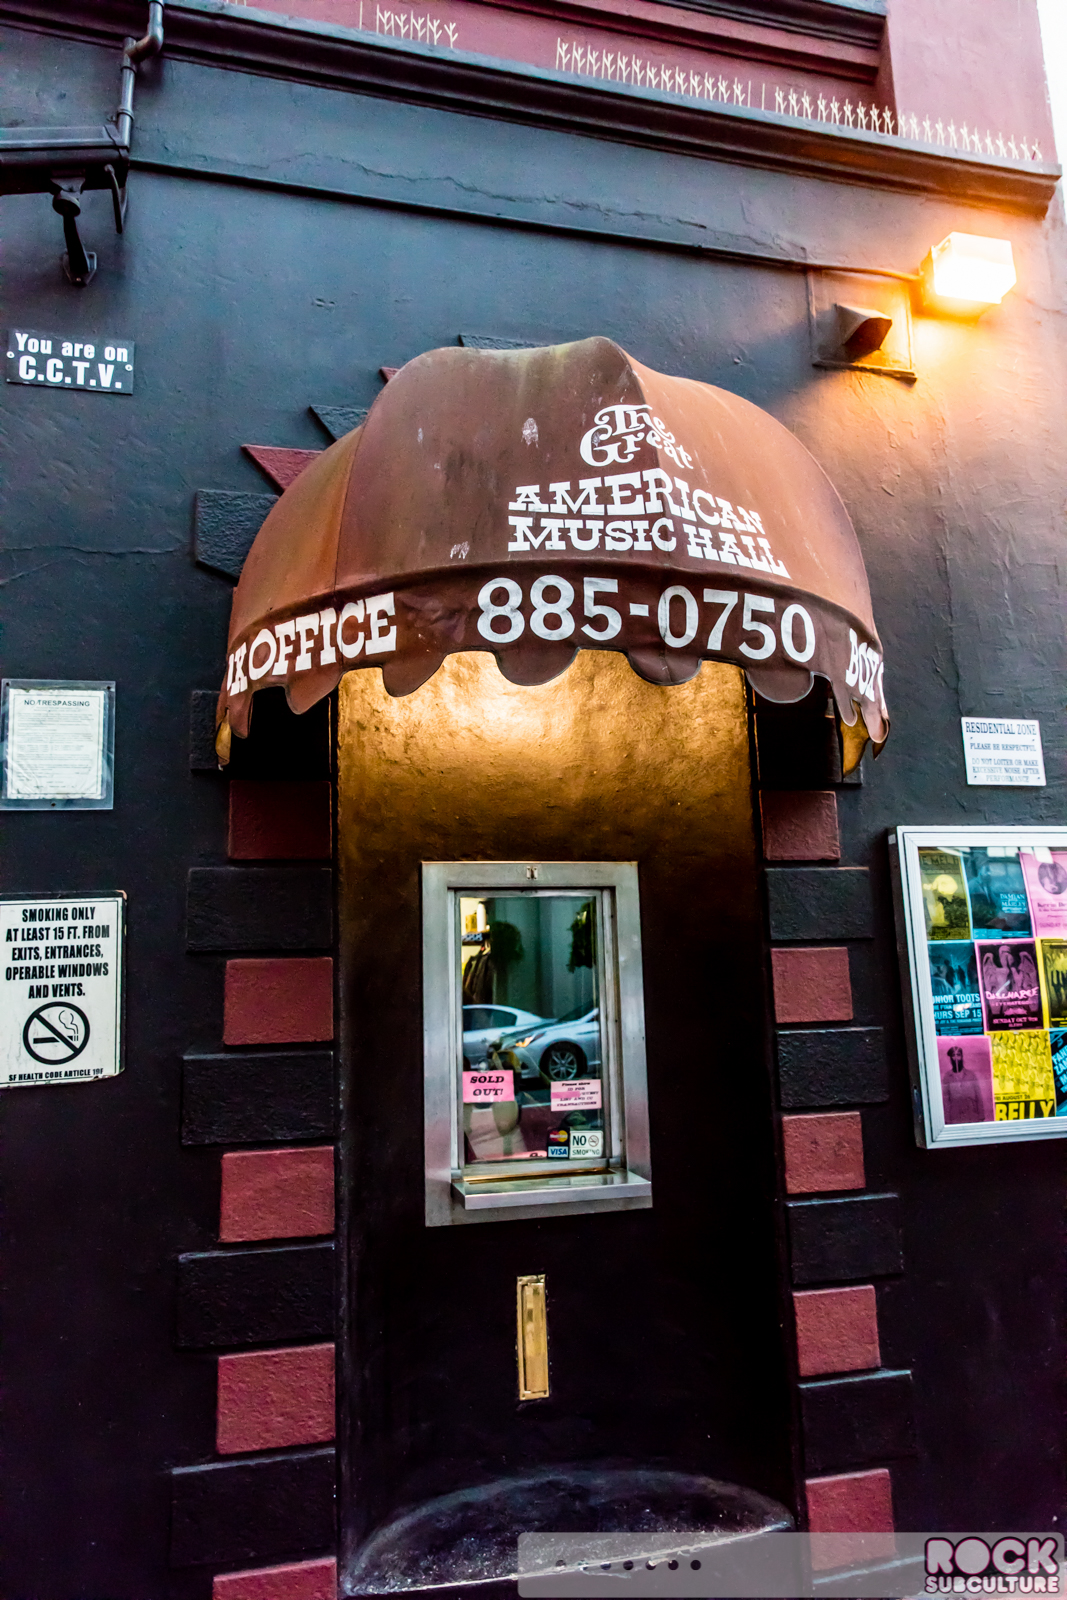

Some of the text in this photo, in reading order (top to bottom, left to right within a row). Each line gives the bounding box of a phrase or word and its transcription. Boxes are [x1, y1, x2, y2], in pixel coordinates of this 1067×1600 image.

[15, 332, 128, 362] You are on
[19, 355, 122, 388] C.C.T.V.
[594, 404, 676, 443] The
[579, 424, 694, 470] Great
[508, 467, 766, 535] AMERICAN
[508, 515, 792, 580] MUSIC HALL
[477, 574, 816, 664] 885-0750
[248, 592, 397, 681] OFFICE
[845, 628, 880, 702] BOX
[37, 699, 91, 707] TRESPASSING
[965, 721, 1037, 735] RESIDENTIAL ZONE
[970, 742, 992, 750] PLEASE
[993, 743, 1001, 751] BE
[994, 758, 1014, 766] LOITER
[22, 906, 96, 922] SMOKING ONLY
[5, 924, 110, 942] AT LEAST 15 FT. FROM
[12, 944, 104, 961] EXITS, ENTRANCES,
[5, 962, 109, 981] OPERABLE WINDOWS
[28, 982, 86, 999] AND VENTS.
[955, 993, 981, 1003] TOOTS
[955, 1009, 970, 1019] SEP
[972, 1009, 982, 1018] 15
[18, 1072, 43, 1081] HEALTH
[44, 1070, 62, 1079] CODE
[63, 1068, 91, 1077] ARTICLE
[469, 1075, 505, 1084] SOLD
[472, 1088, 504, 1097] OUT!
[995, 1100, 1054, 1121] BELLY
[572, 1134, 588, 1147] NO
[550, 1148, 568, 1156] VISA
